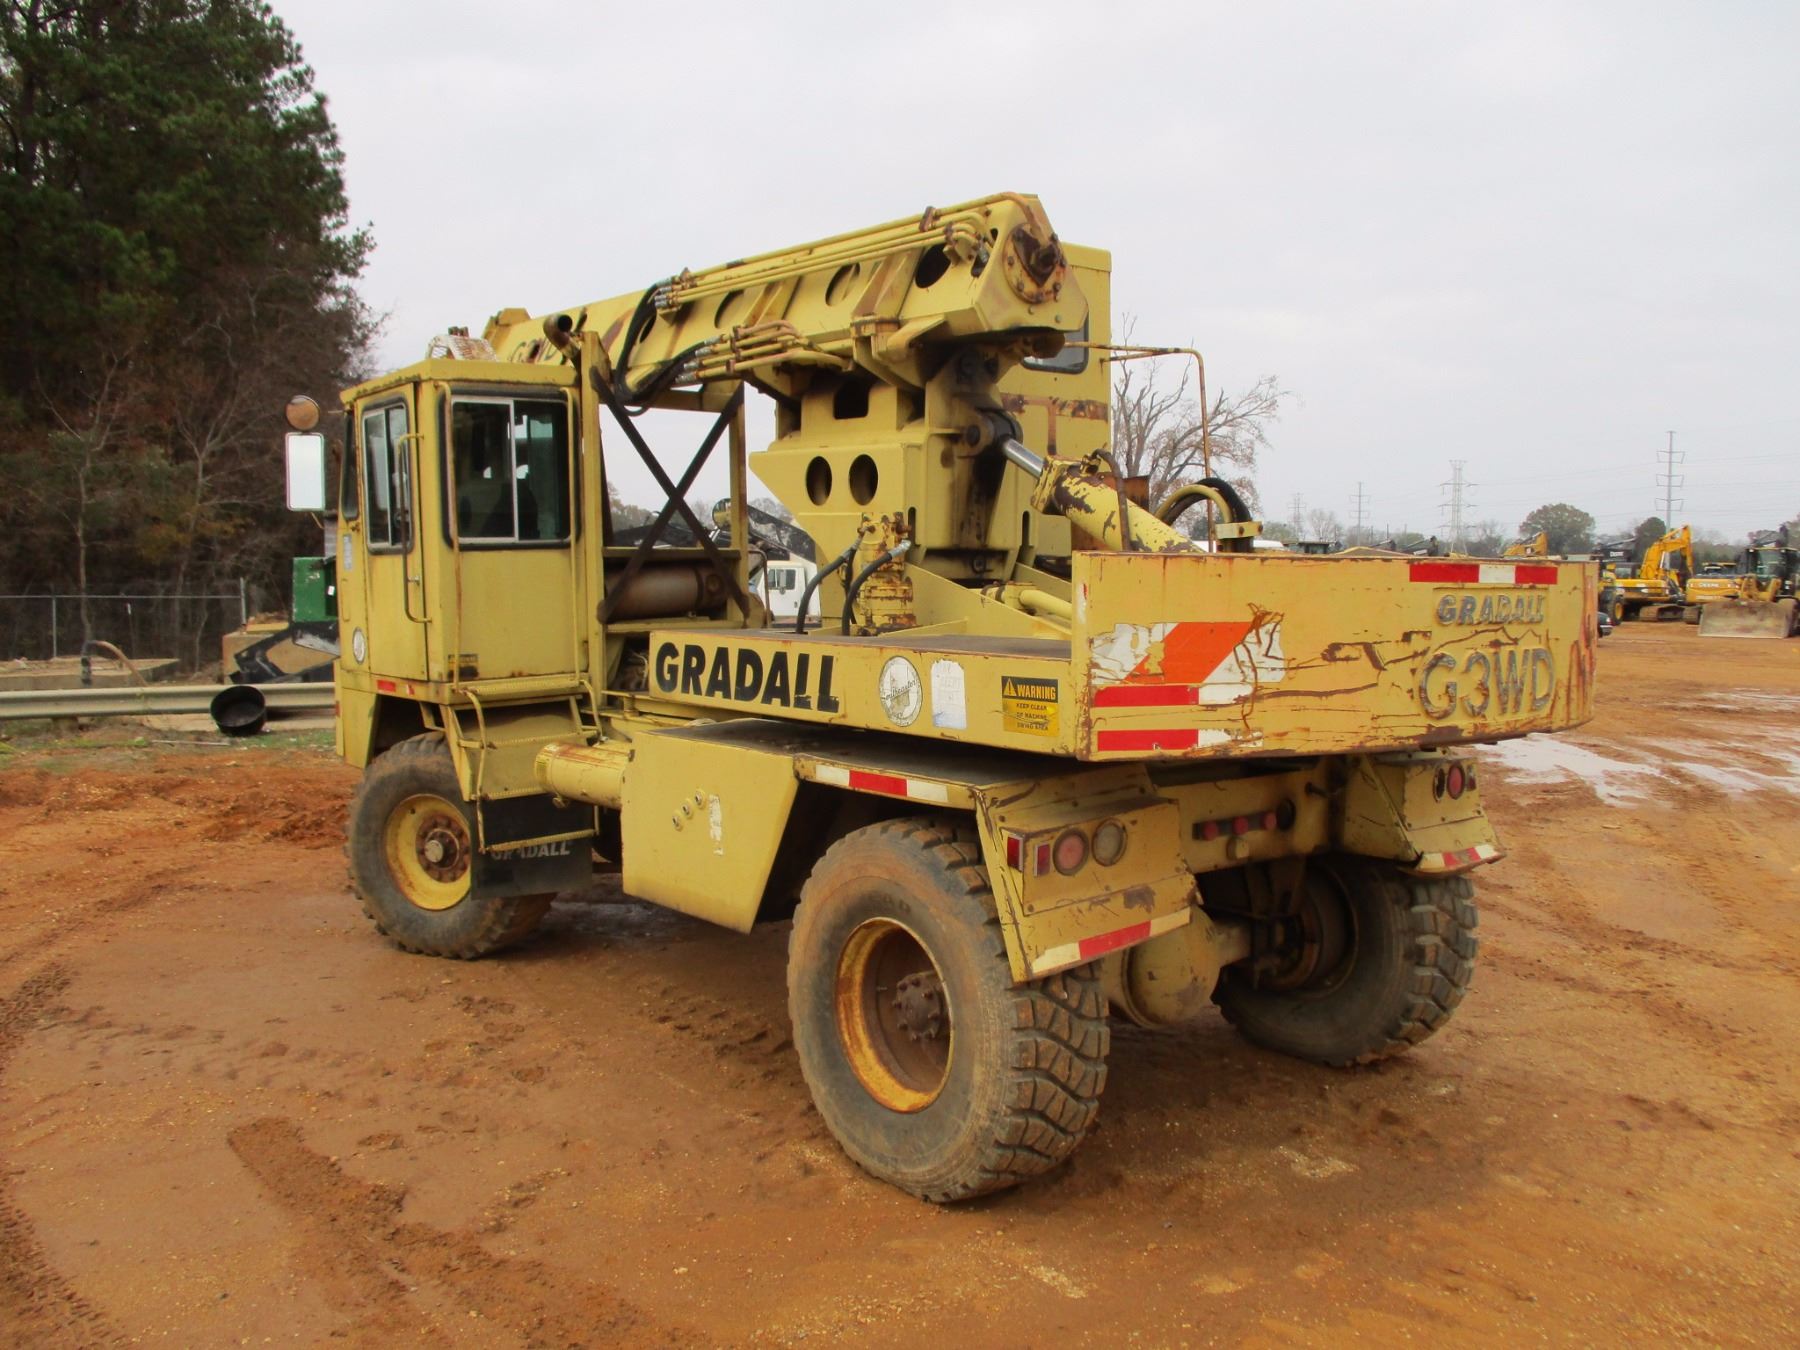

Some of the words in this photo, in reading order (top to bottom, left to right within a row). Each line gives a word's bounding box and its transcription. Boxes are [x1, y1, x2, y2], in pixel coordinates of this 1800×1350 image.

[1437, 594, 1546, 626] GRADALL
[655, 641, 840, 714] GRADALL
[1017, 684, 1056, 700] WARNING
[1419, 648, 1553, 720] G3WD
